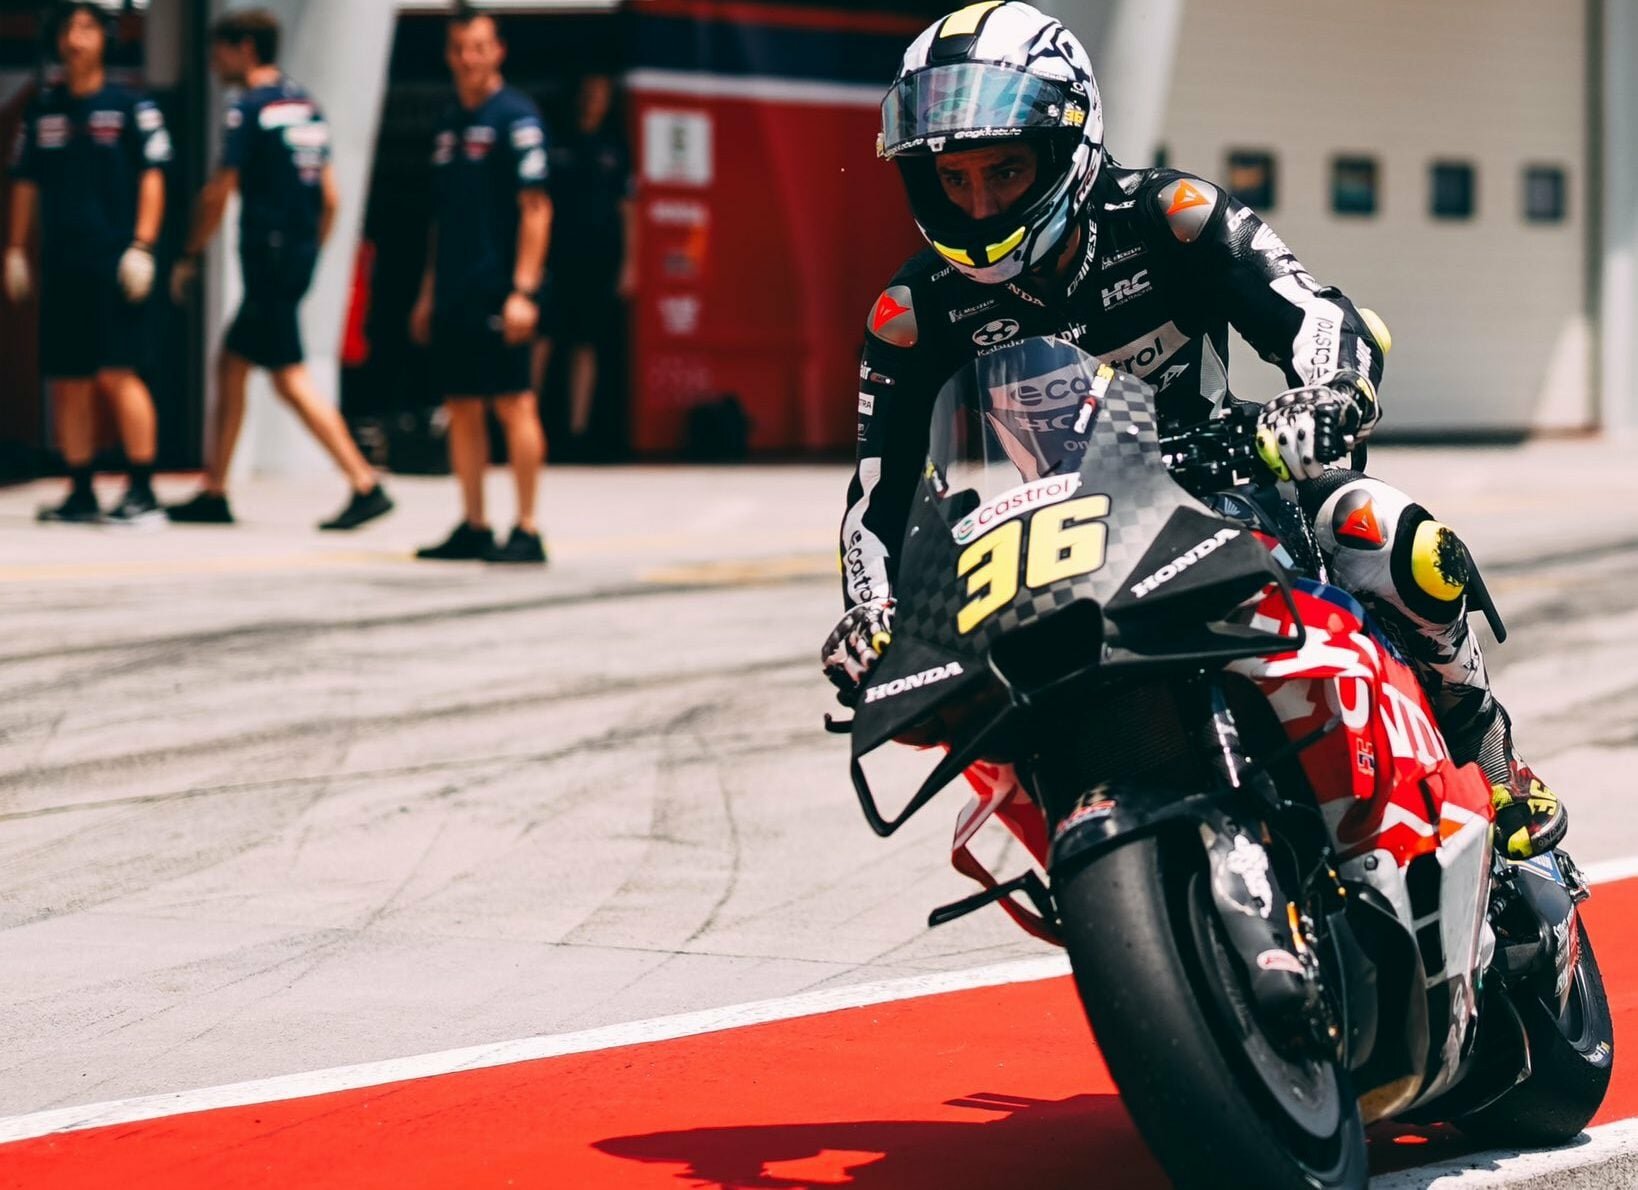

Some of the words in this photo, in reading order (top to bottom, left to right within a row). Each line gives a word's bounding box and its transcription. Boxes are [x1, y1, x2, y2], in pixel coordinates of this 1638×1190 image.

[1007, 283, 1046, 307] NDA
[1101, 269, 1150, 307] HRC
[978, 479, 1069, 525] Castrol
[957, 494, 1112, 635] 36
[1130, 528, 1241, 598] HONDA
[864, 661, 964, 703] HONDA
